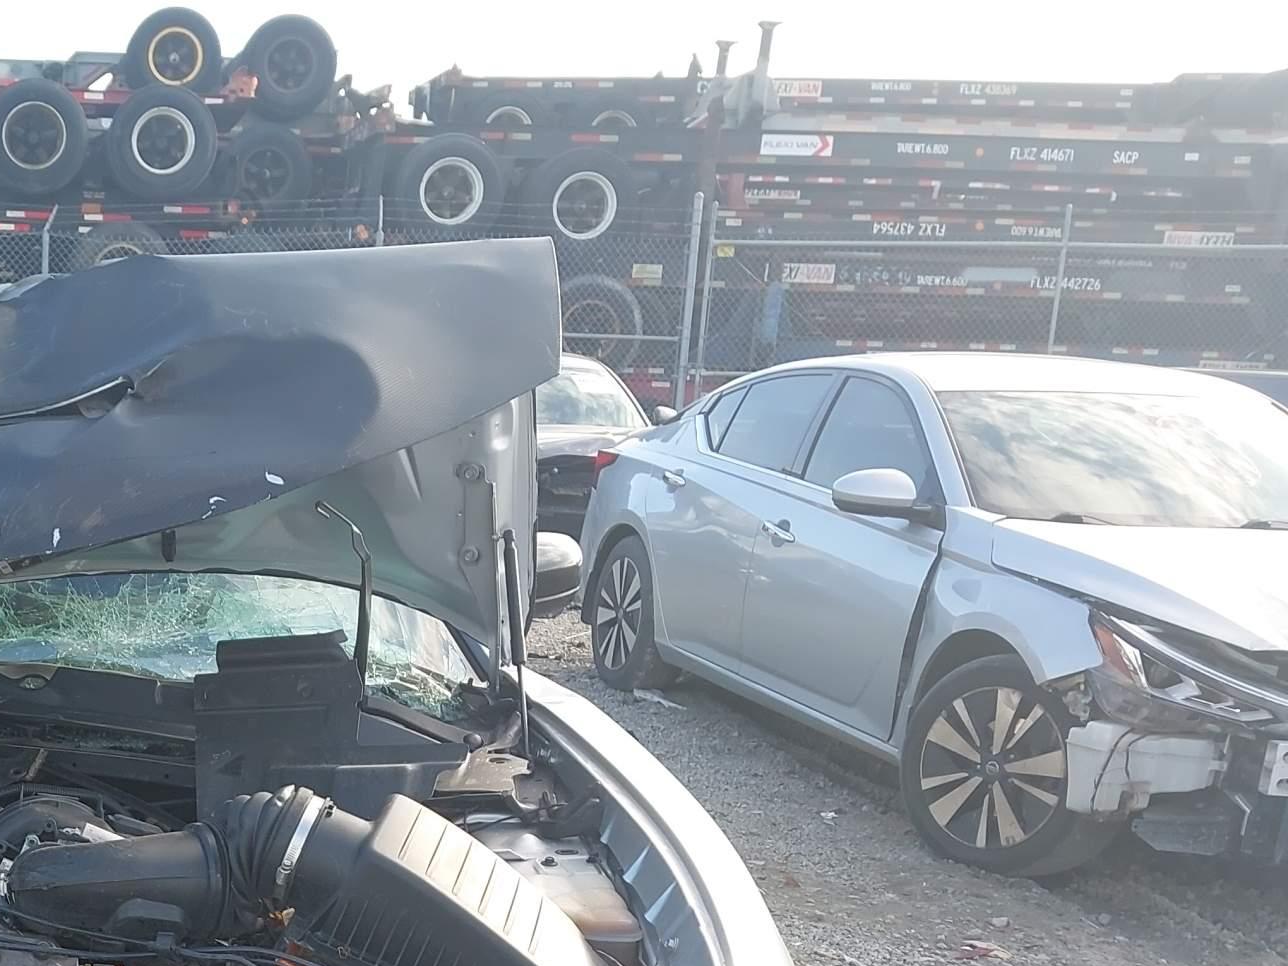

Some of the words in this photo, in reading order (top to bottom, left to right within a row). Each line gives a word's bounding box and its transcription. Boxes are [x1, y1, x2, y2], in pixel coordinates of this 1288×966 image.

[960, 83, 982, 95] FLXZ
[1010, 147, 1037, 161] FLXZ
[1040, 148, 1074, 162] 414671
[1113, 150, 1139, 164] SACP
[872, 221, 914, 234] 437564
[918, 223, 946, 237] FLXZ
[1030, 276, 1057, 289] FLXZ
[1061, 277, 1101, 291] 442726
